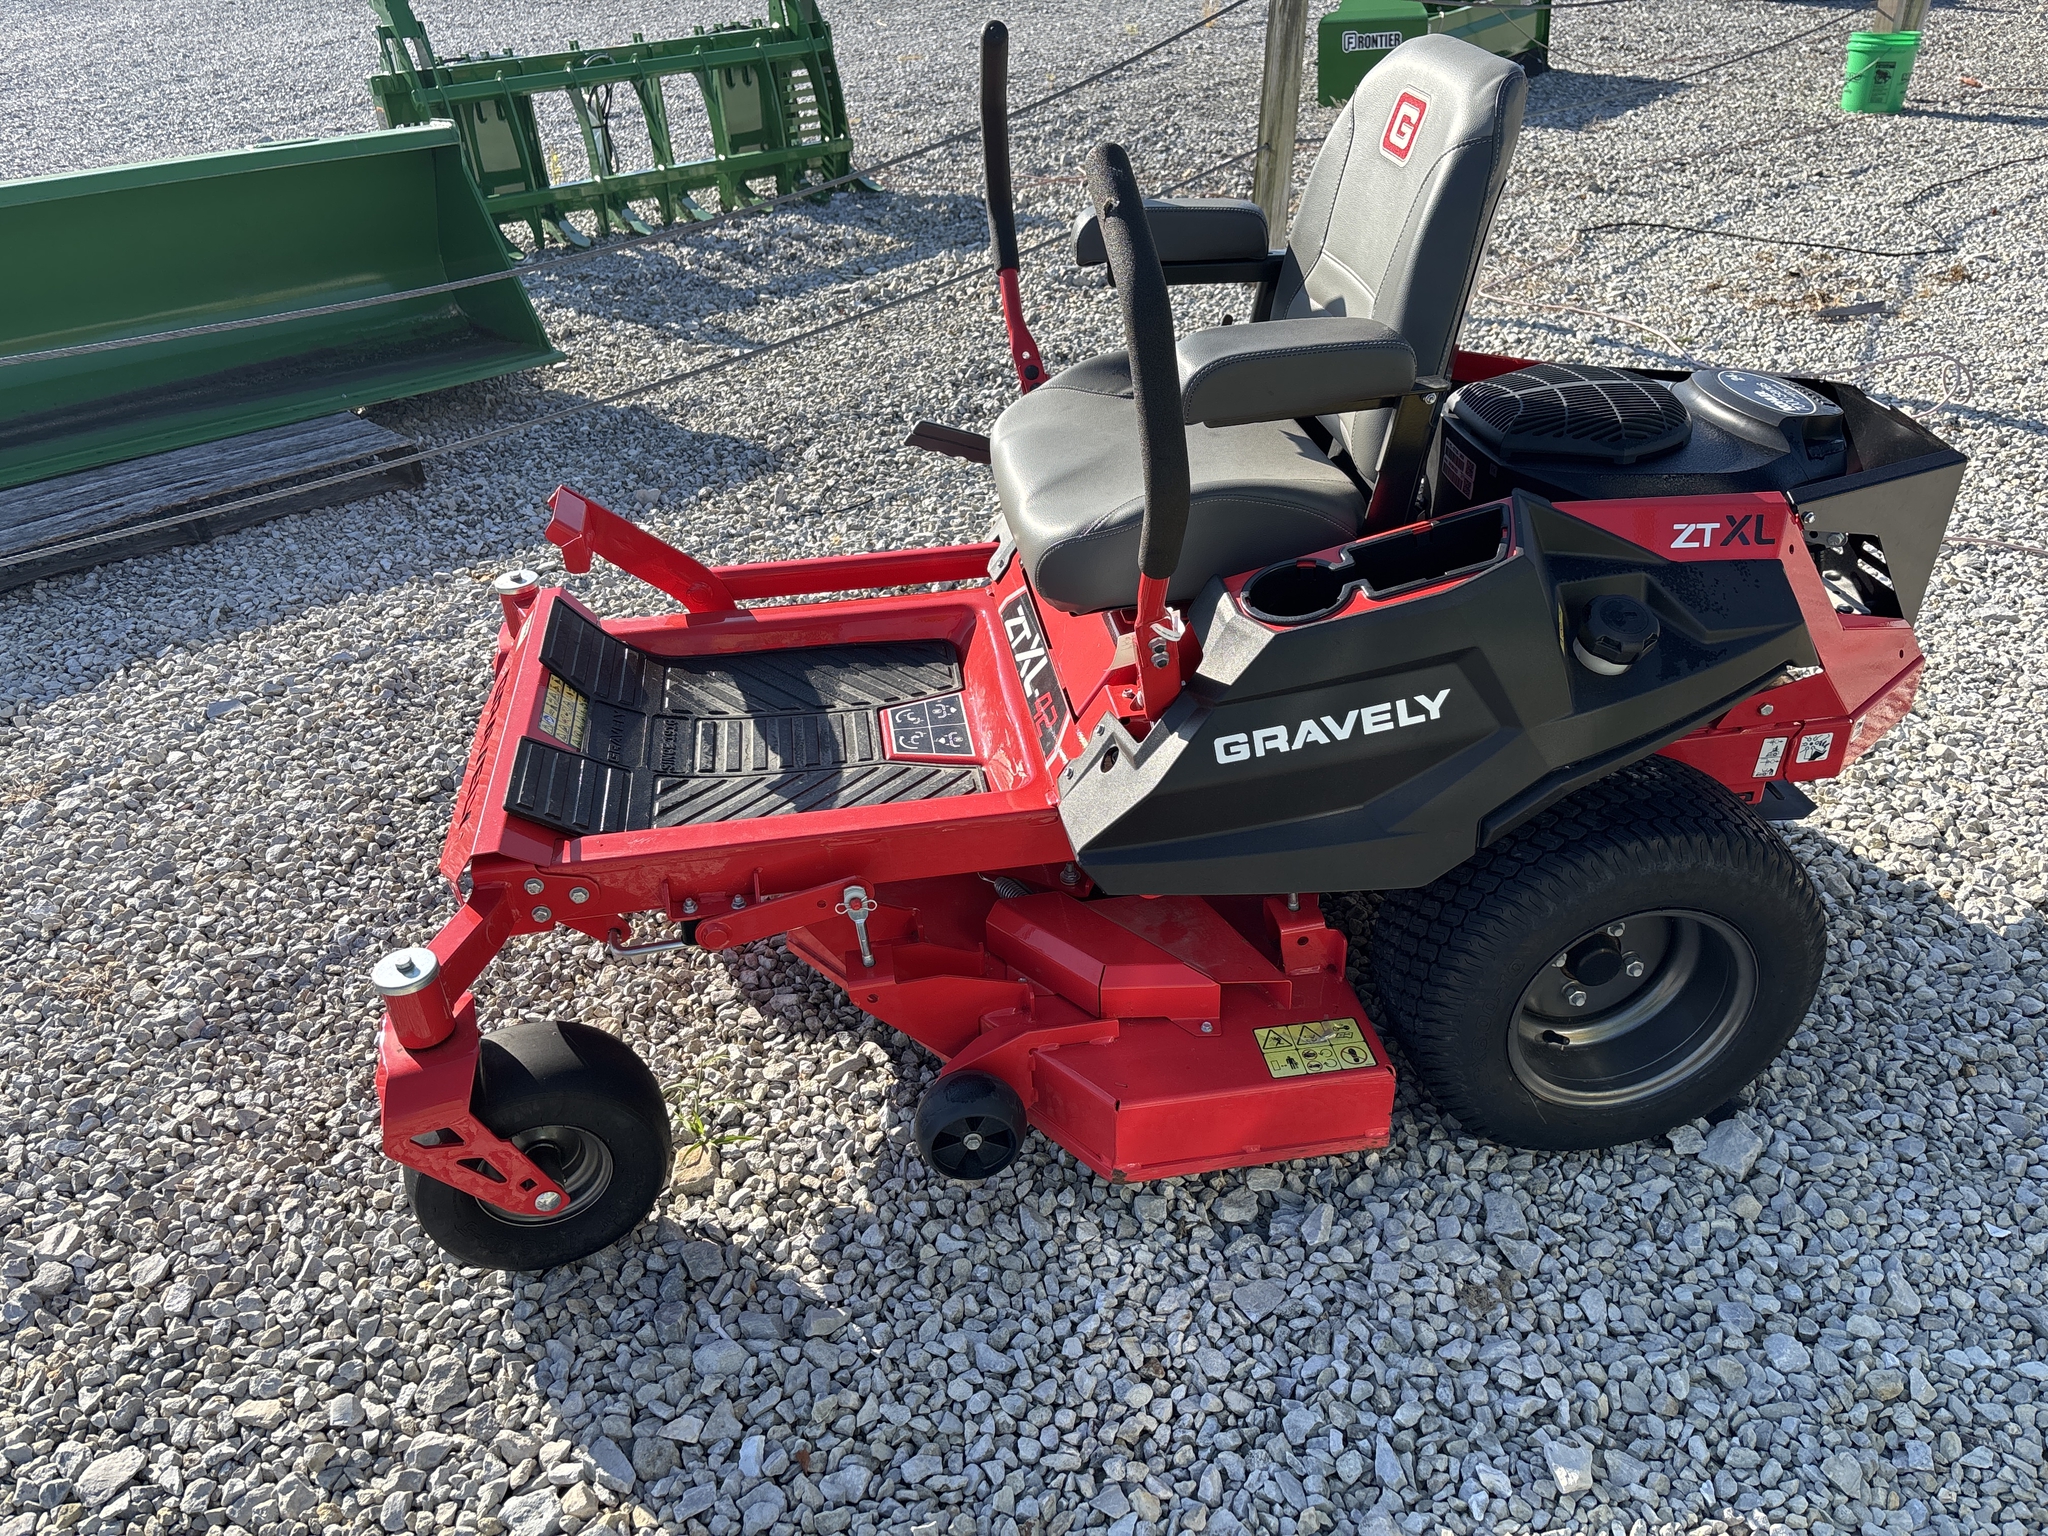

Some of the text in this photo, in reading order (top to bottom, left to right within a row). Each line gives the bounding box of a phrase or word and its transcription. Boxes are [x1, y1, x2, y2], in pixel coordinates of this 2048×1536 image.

[1344, 32, 1401, 51] FRONTIER
[1389, 101, 1420, 150] G
[1214, 687, 1451, 765] GRAVELY
